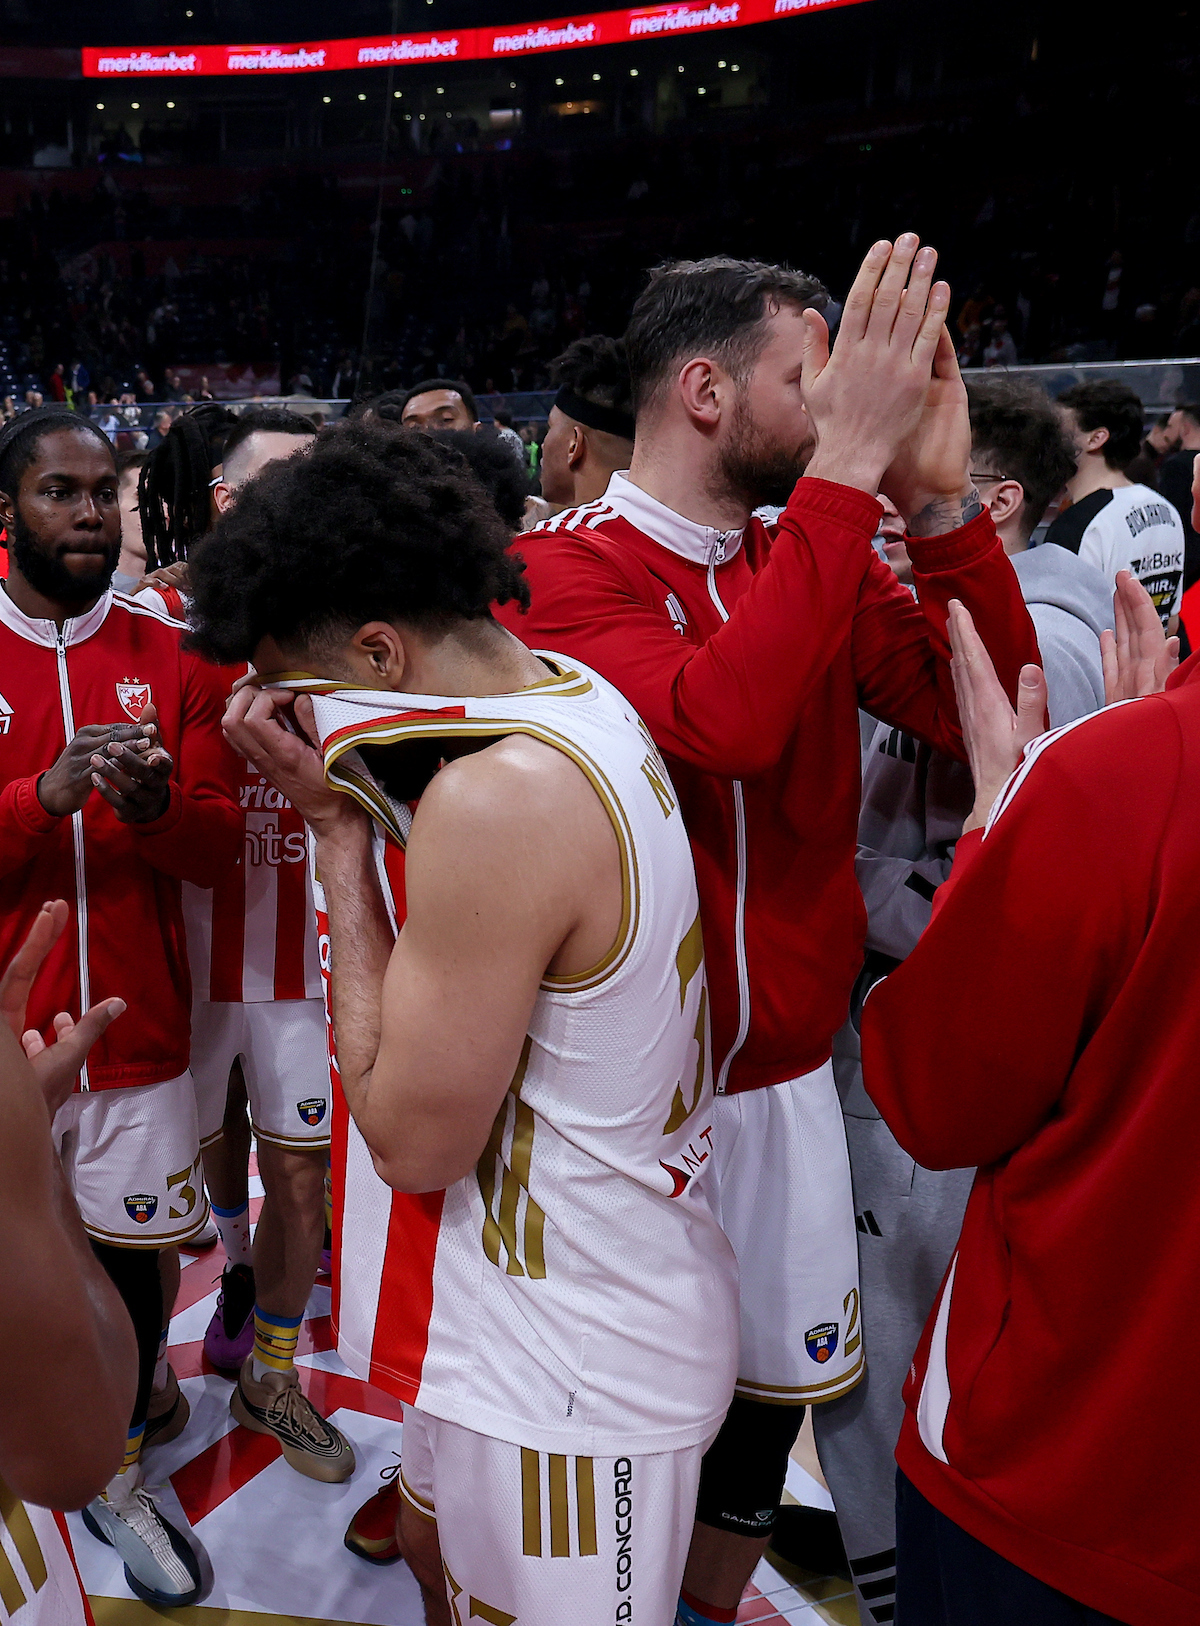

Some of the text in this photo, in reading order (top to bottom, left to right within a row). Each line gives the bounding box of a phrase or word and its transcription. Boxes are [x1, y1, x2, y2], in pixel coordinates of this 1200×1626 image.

[630, 2, 738, 34] meridianbet
[358, 37, 458, 63] meridianbet
[493, 22, 595, 52] meridianbet
[98, 51, 197, 73] meridianbet
[228, 48, 327, 70] meridianbet
[613, 1456, 633, 1593] CONCORD
